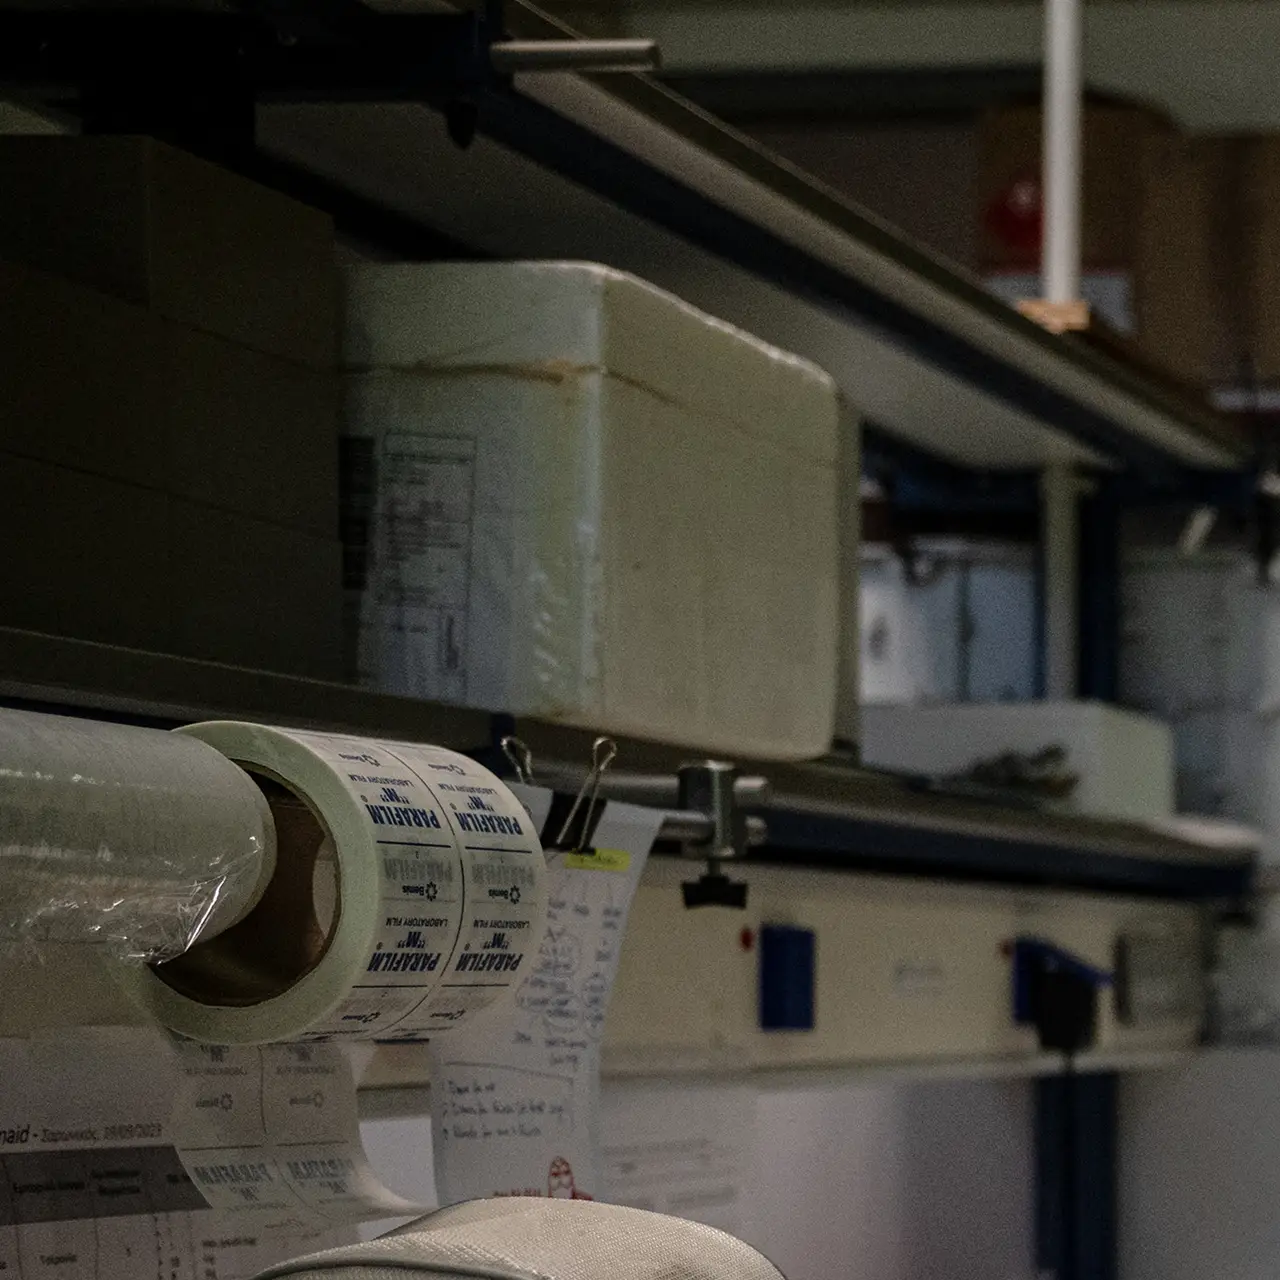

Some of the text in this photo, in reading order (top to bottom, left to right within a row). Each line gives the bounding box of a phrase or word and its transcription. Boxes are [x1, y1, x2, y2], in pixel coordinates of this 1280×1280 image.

[367, 776, 416, 789] LABORATORY
[364, 803, 442, 829] PARAFILM
[454, 811, 525, 836] PARAFILM
[402, 885, 424, 897] Bemis
[385, 917, 449, 928] LABORATORY FILM
[473, 919, 530, 929] LABORATORY FILM
[366, 952, 442, 972] PARAFILM
[454, 952, 524, 972] PARAFILM
